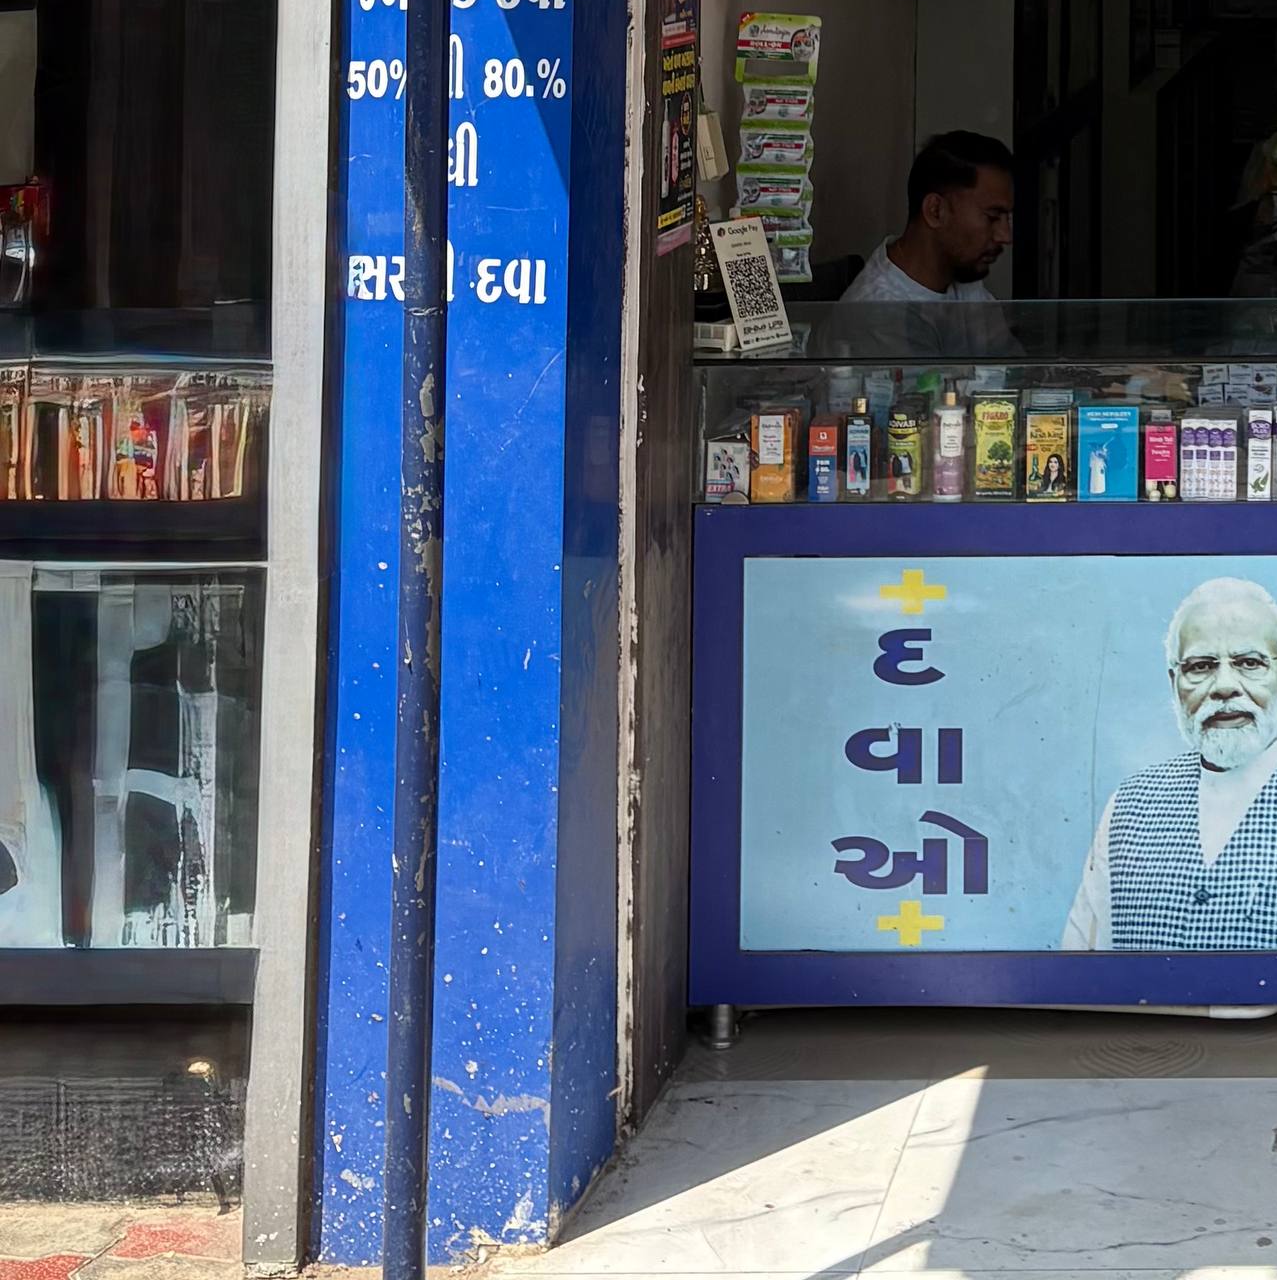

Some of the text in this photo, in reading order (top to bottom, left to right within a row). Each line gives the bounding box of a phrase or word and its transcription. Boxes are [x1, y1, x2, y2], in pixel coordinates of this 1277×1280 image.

[483, 57, 567, 100] 80.%
[727, 223, 759, 236] Google Pay
[476, 258, 547, 304] દવા
